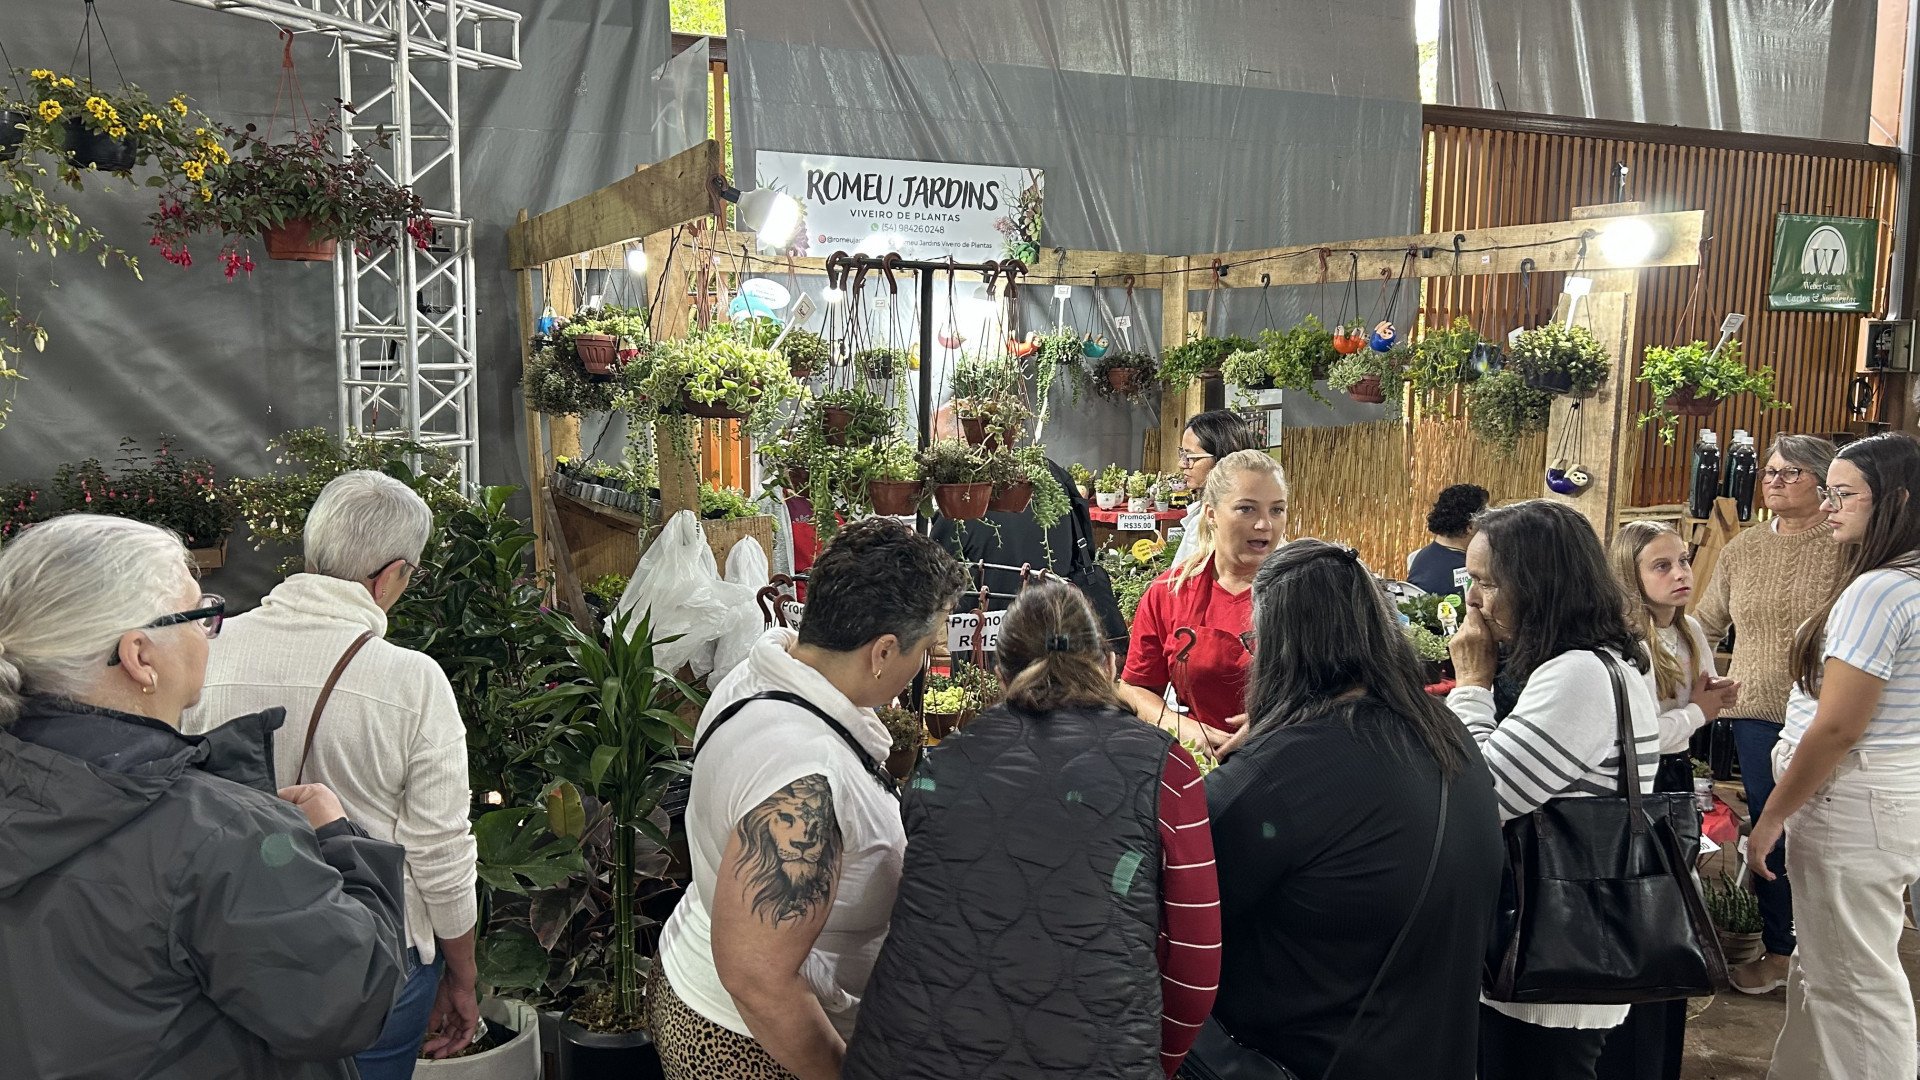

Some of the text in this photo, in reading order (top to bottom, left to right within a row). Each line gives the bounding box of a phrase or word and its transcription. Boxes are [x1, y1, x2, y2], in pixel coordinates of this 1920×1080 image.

[807, 169, 999, 211] ROMEU JARDINS
[850, 209, 961, 222] VIVEIRO DE PLANTAS
[882, 223, 945, 234] (54) 98426 0248
[919, 239, 941, 247] Jardins
[971, 241, 993, 249] Plantas
[1786, 293, 1811, 303] Cactos
[1119, 513, 1155, 521] Promoção
[782, 600, 803, 616] Pro
[958, 633, 998, 648] R15
